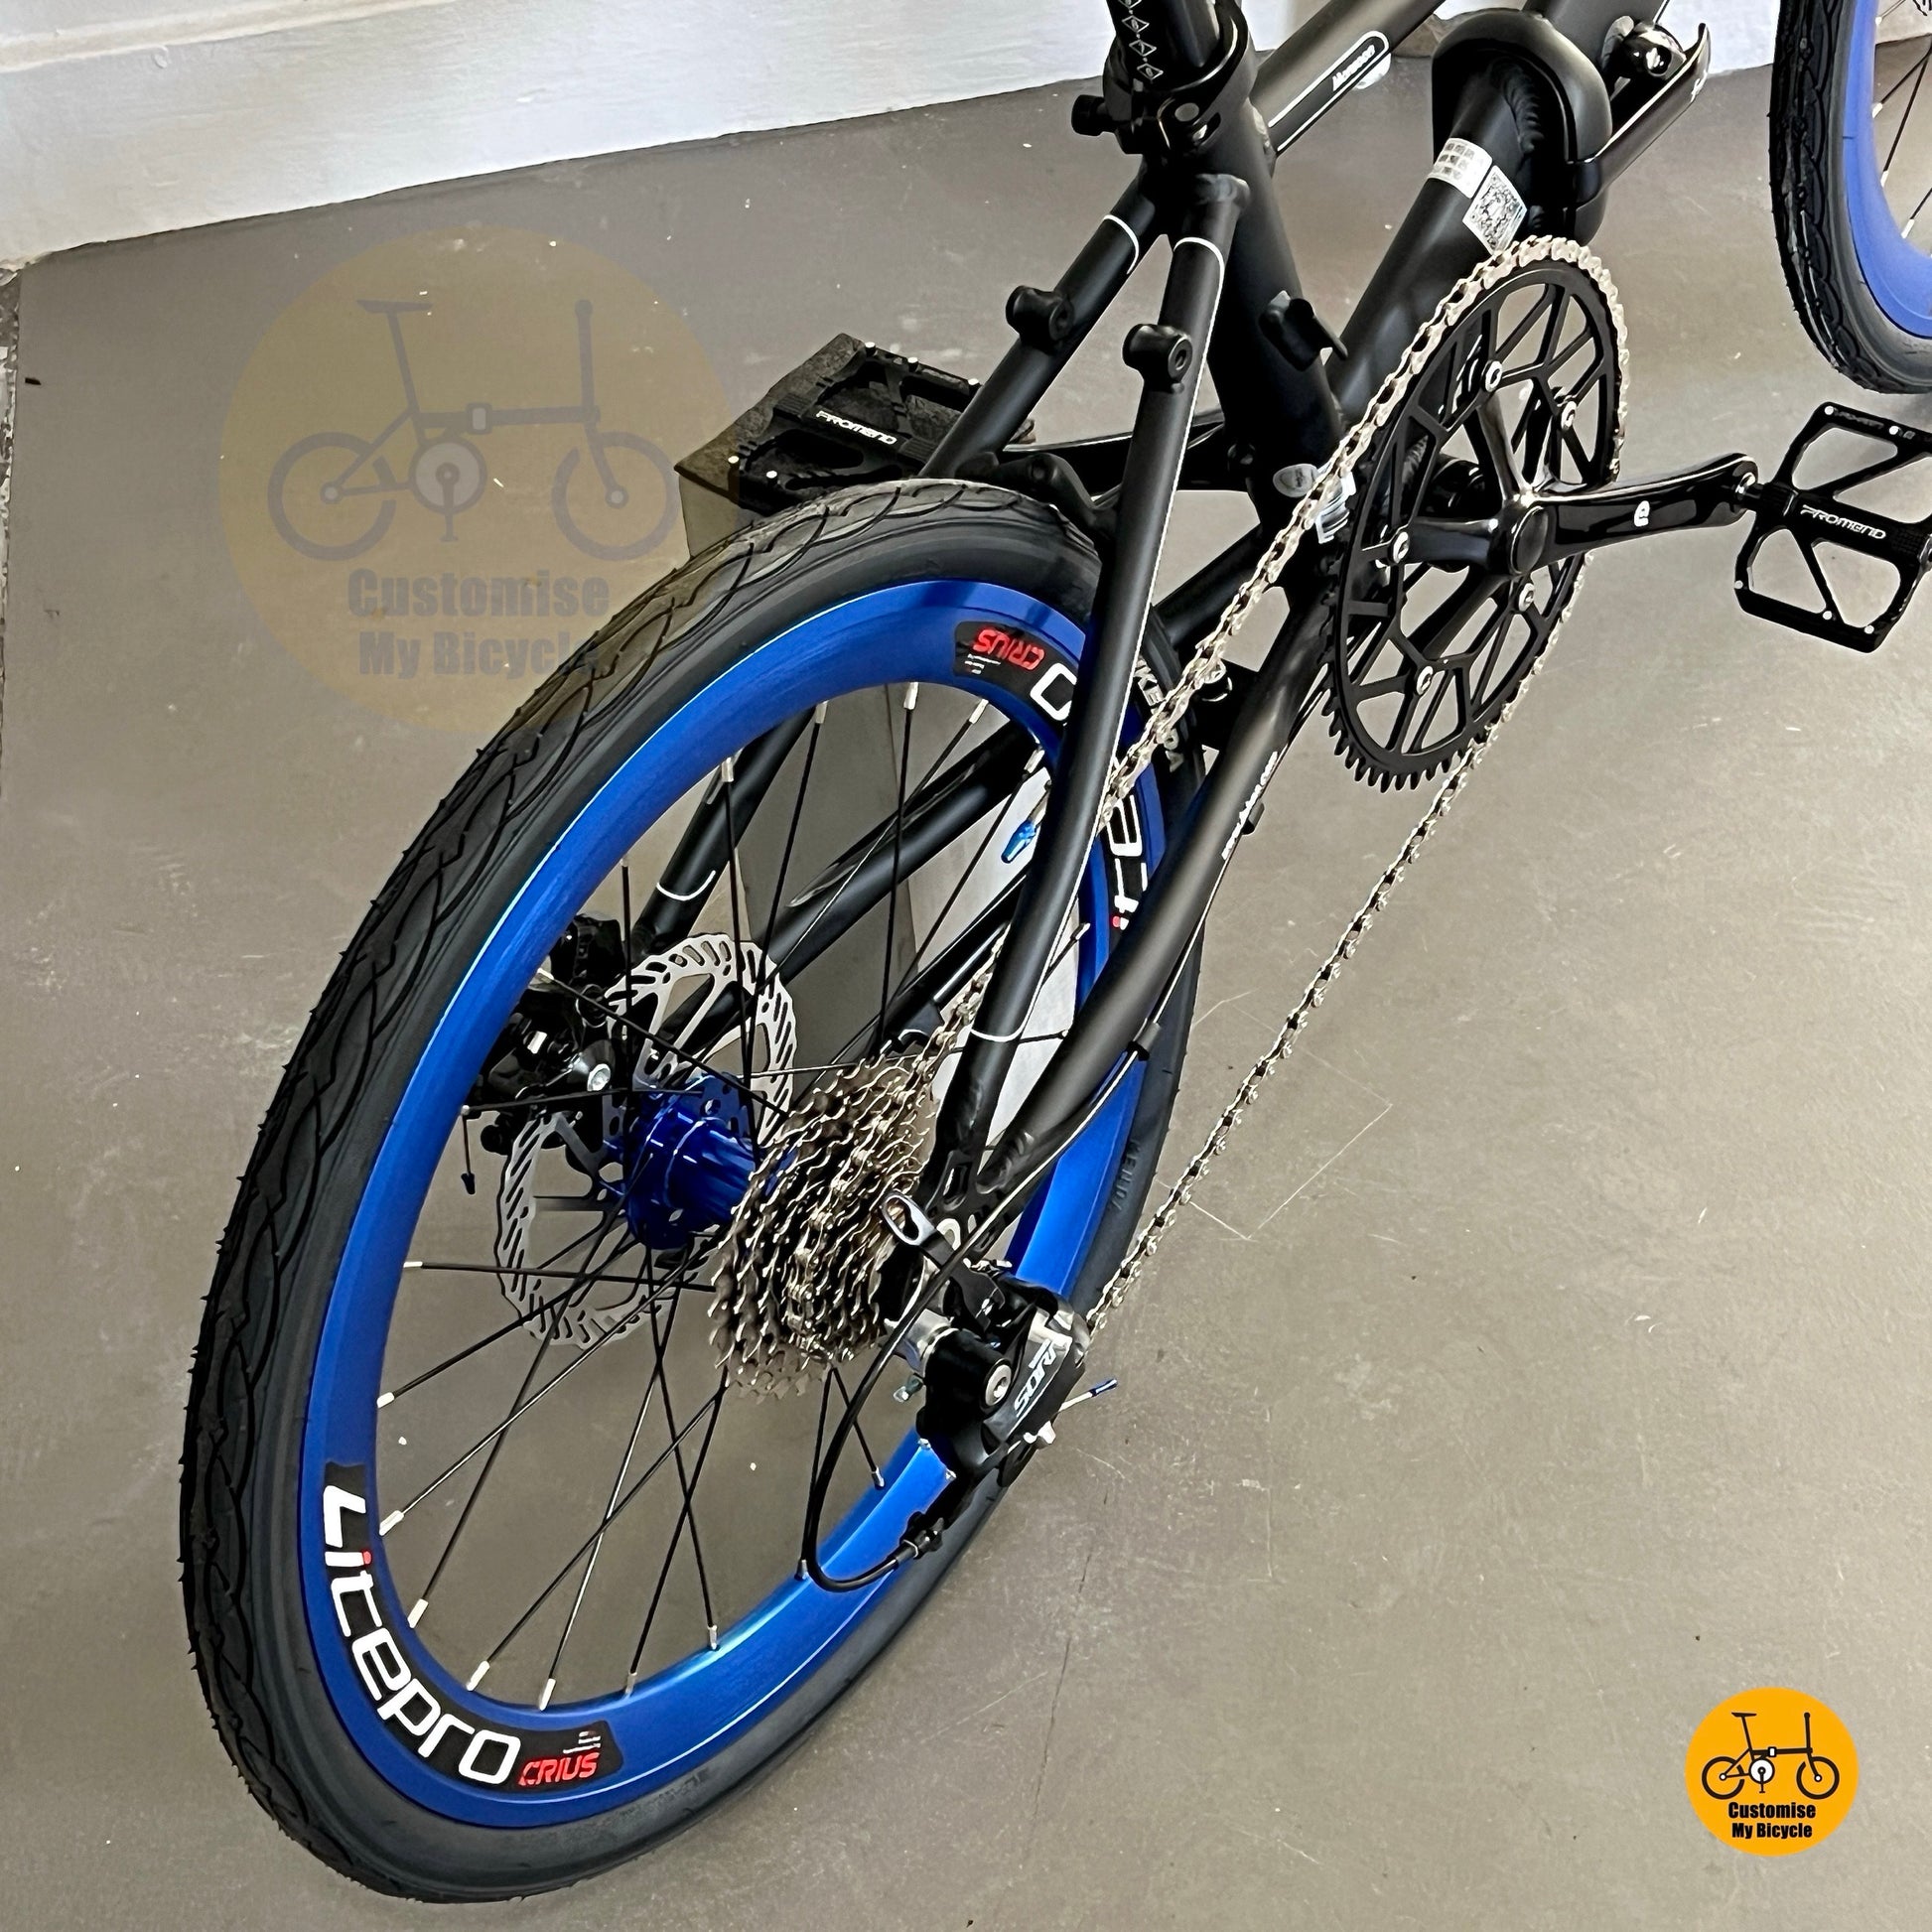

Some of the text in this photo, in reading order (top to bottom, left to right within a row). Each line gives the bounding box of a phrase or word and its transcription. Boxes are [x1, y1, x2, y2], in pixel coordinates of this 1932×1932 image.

[1800, 504, 1886, 539] PROMEND
[973, 628, 1045, 671] CRIUS
[1134, 665, 1184, 773] KEDA
[323, 1484, 600, 1786] Litepro CRIUS
